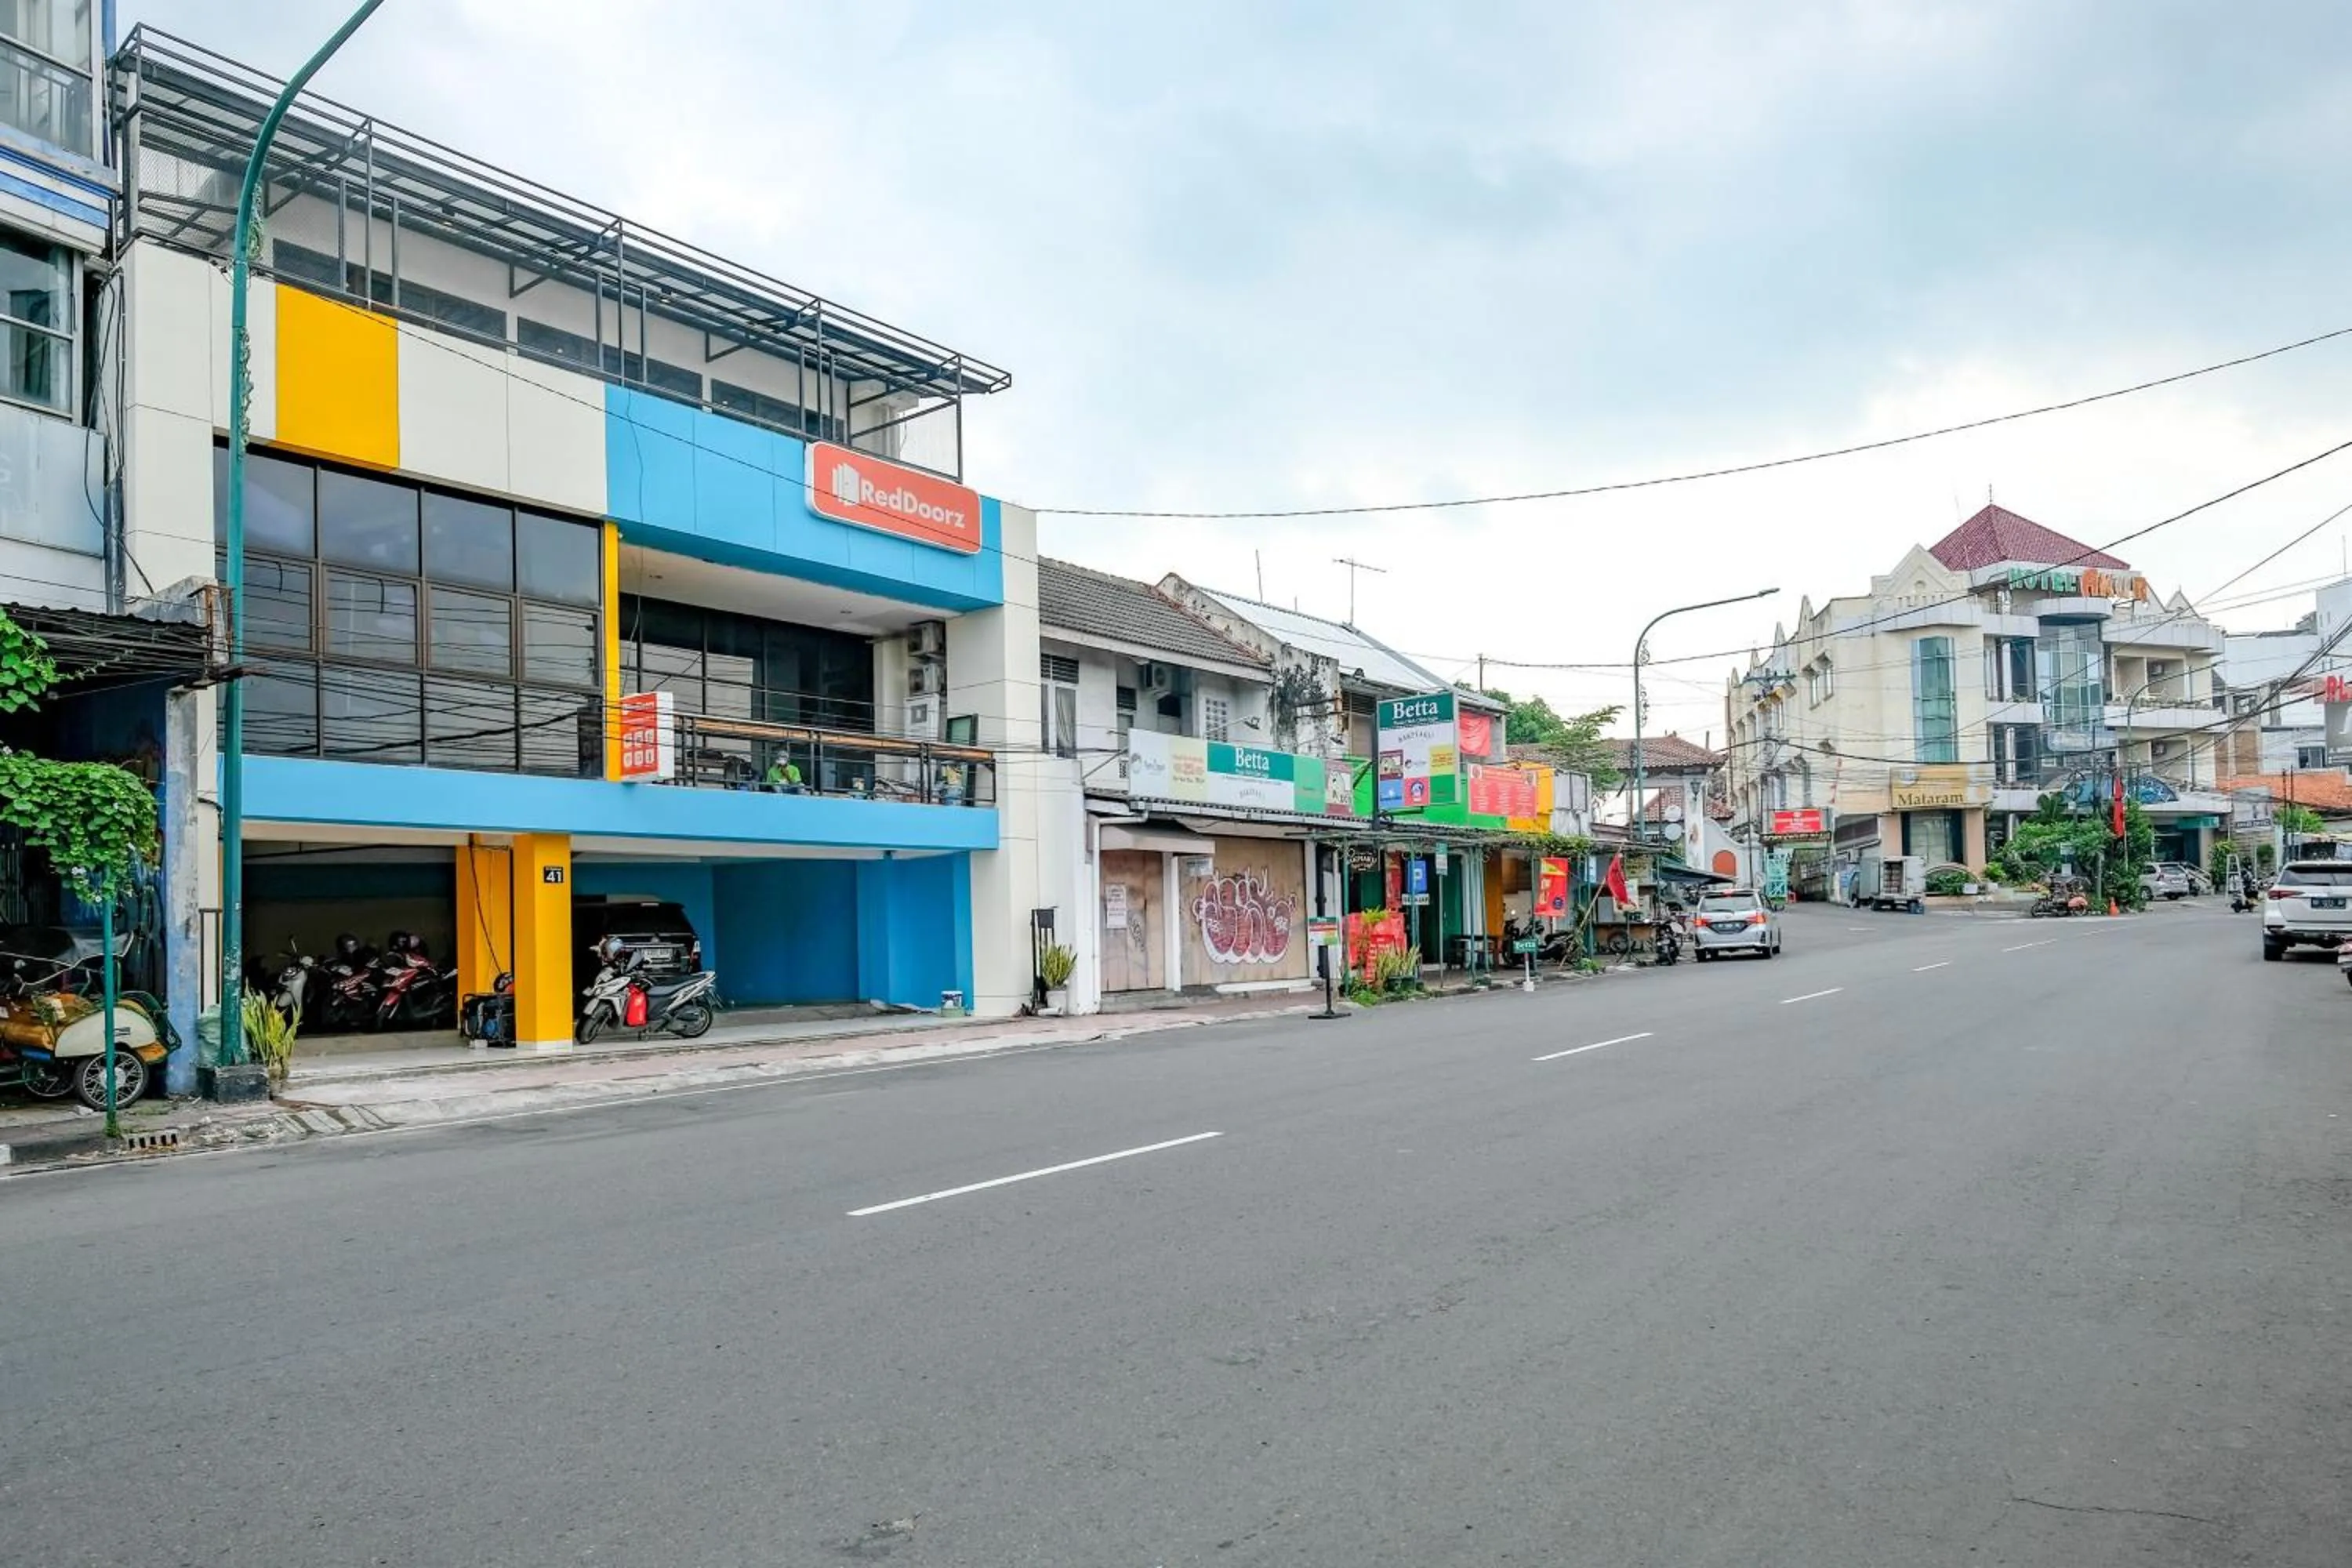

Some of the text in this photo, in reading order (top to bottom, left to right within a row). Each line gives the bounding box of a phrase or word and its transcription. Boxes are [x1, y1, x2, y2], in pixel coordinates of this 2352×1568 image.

[861, 477, 966, 528] RedDoorz
[2008, 566, 2077, 593] HOTEL
[1392, 700, 1439, 720] Betta
[1235, 746, 1269, 770] Betta
[1898, 793, 1964, 805] Mataram
[546, 871, 561, 882] 41
